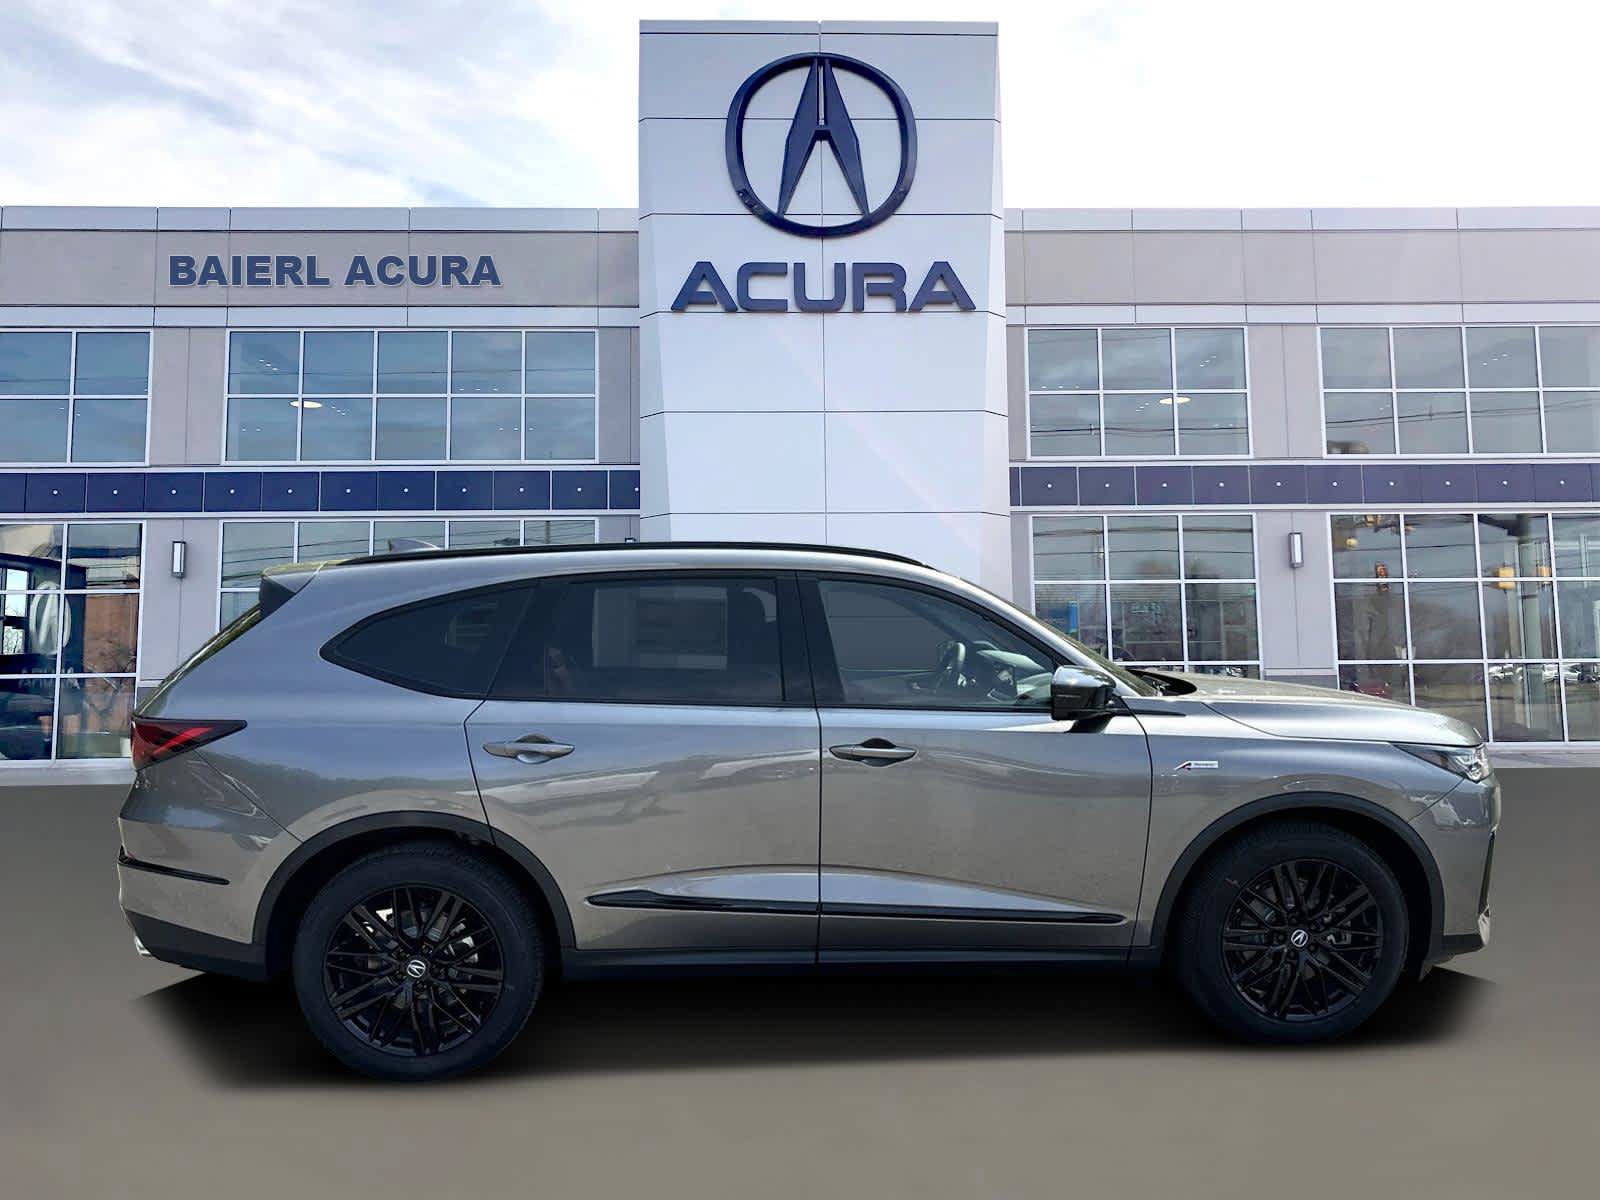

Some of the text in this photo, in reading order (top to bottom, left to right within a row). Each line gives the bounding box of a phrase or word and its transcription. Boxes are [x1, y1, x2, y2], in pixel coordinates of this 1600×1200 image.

[169, 254, 502, 286] BAIERL ACURA
[670, 260, 977, 312] ACURA
